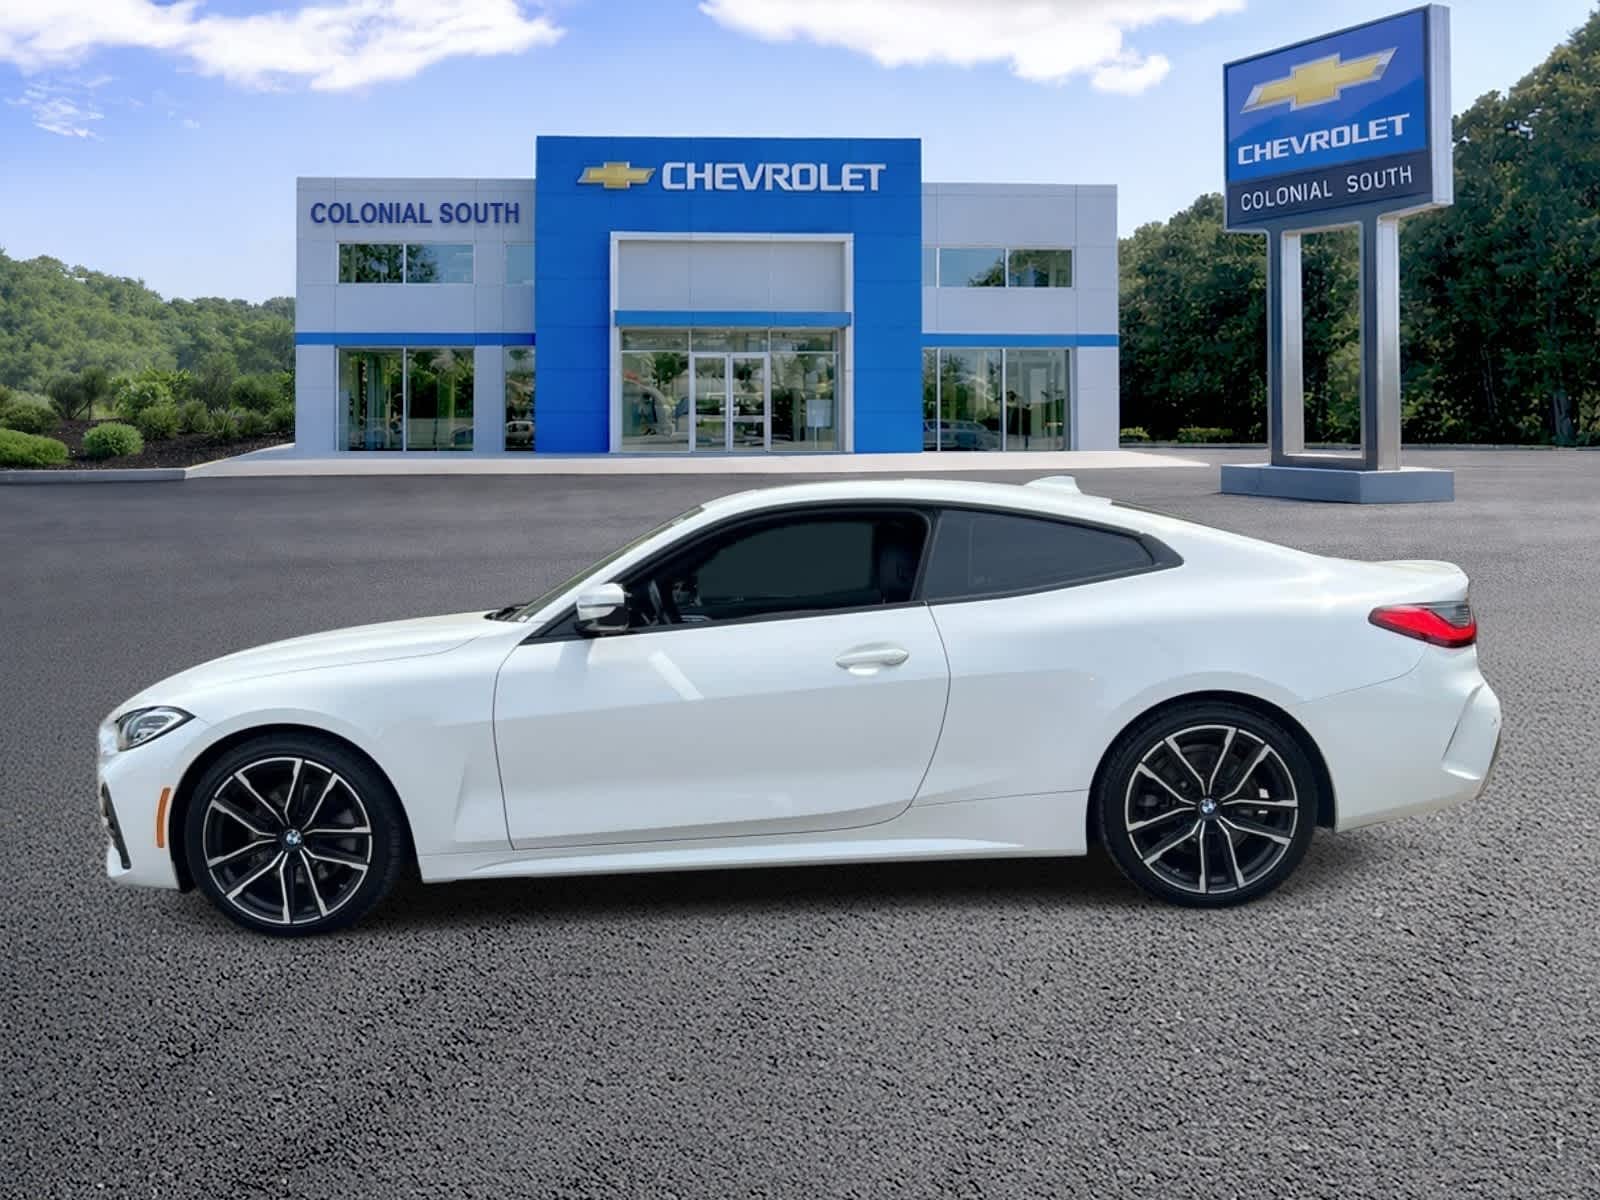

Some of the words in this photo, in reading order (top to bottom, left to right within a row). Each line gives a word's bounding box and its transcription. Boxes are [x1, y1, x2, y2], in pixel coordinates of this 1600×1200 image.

[1237, 113, 1410, 165] CHEVROLET
[662, 161, 887, 191] CHEVROLET
[1240, 180, 1333, 211] COLONIAL
[1346, 165, 1412, 193] SOUTH
[311, 202, 433, 224] COLONIAL
[439, 202, 520, 224] SOUTH
